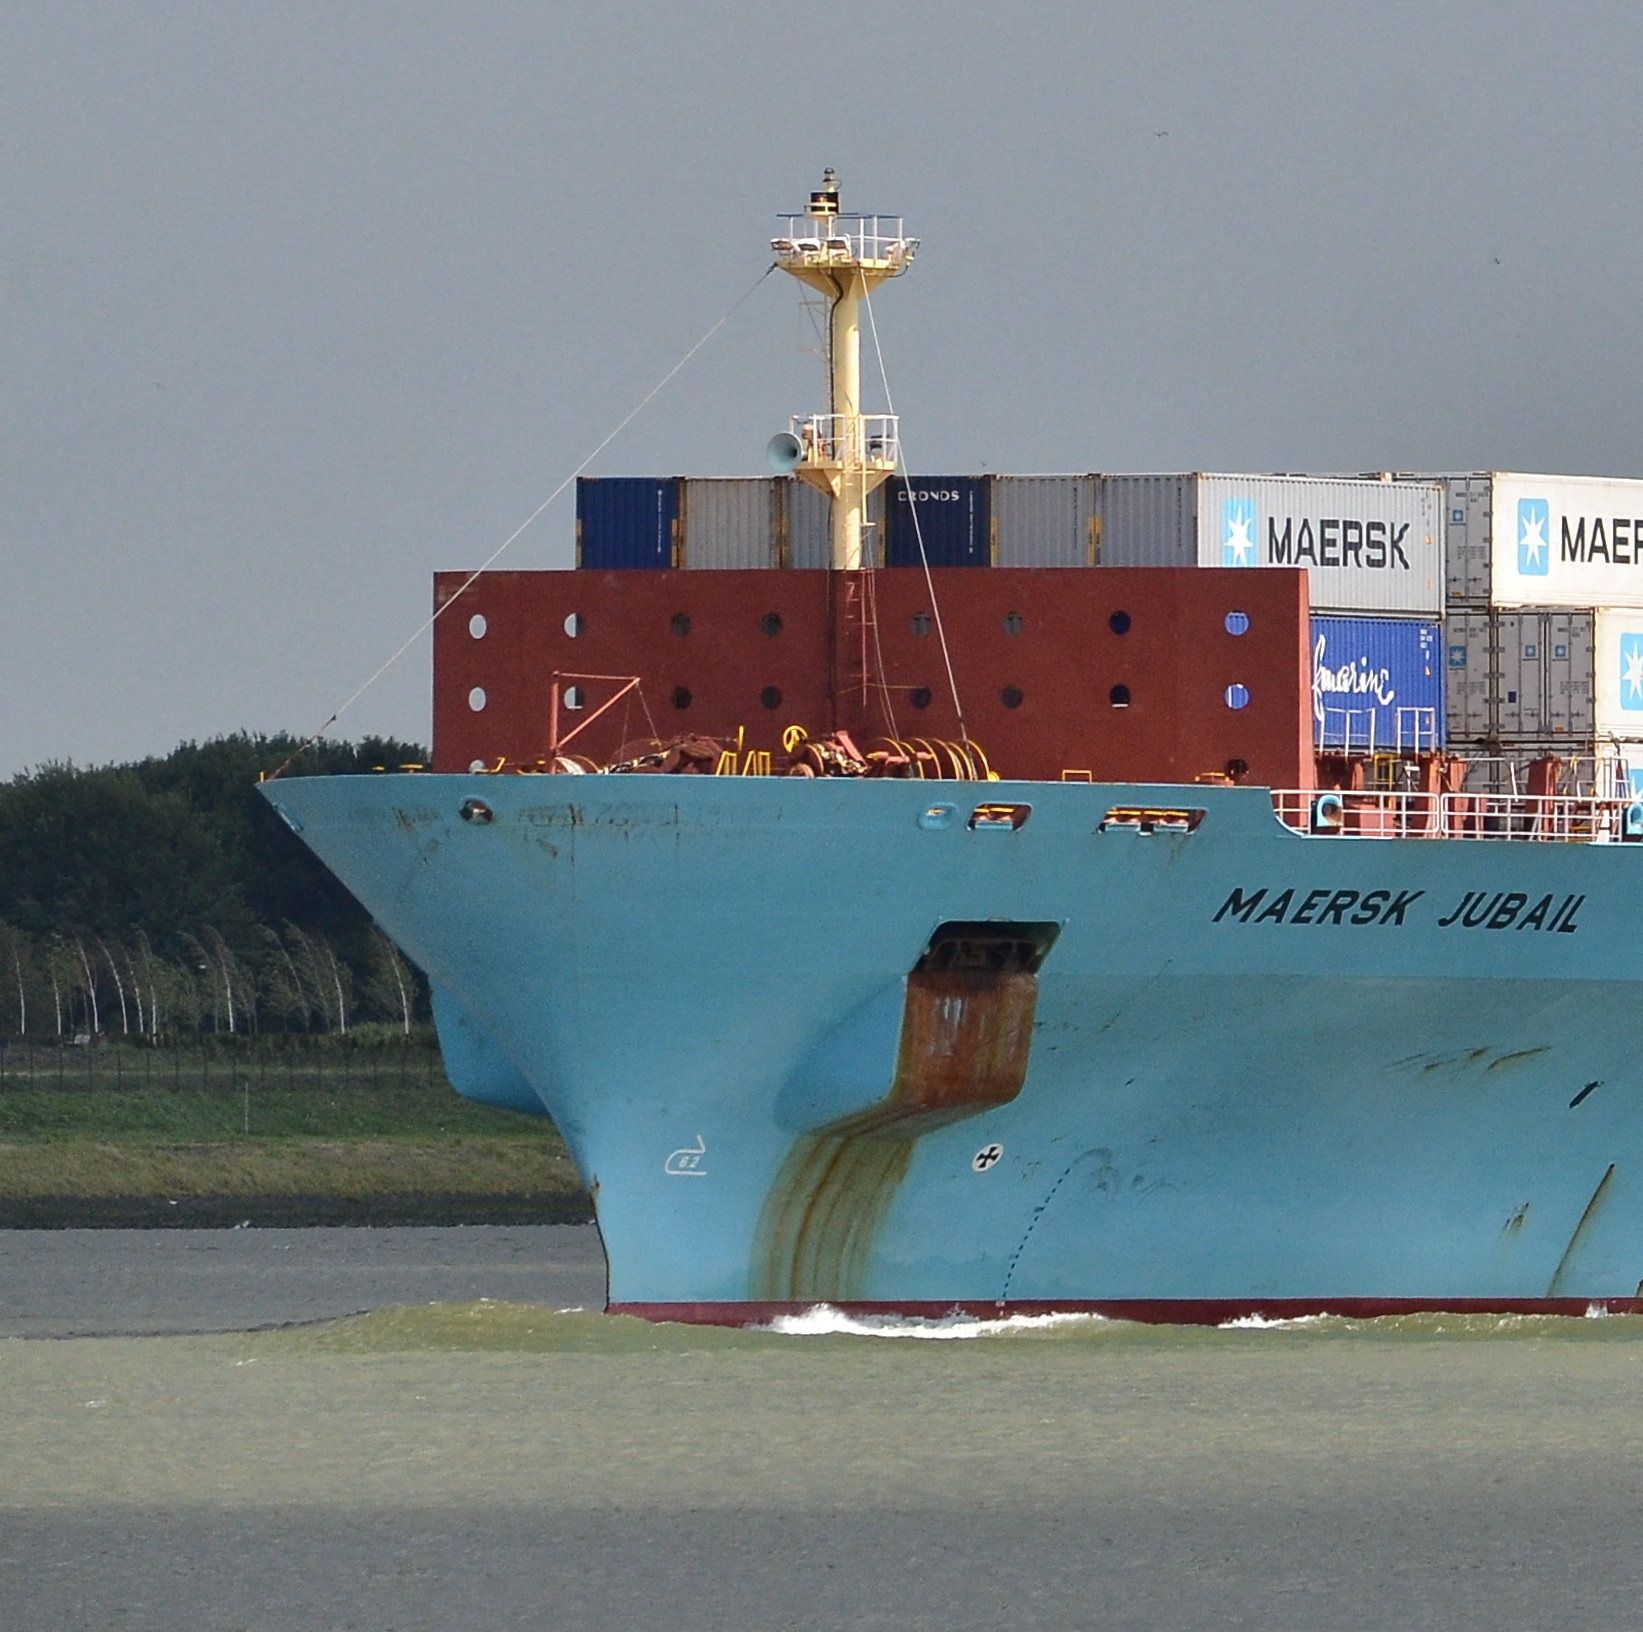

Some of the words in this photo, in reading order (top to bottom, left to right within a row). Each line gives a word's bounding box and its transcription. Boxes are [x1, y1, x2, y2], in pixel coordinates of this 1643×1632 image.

[1269, 517, 1409, 569] MAERSK
[1212, 888, 1425, 925] MAERSK
[1438, 892, 1585, 933] JUBAIL
